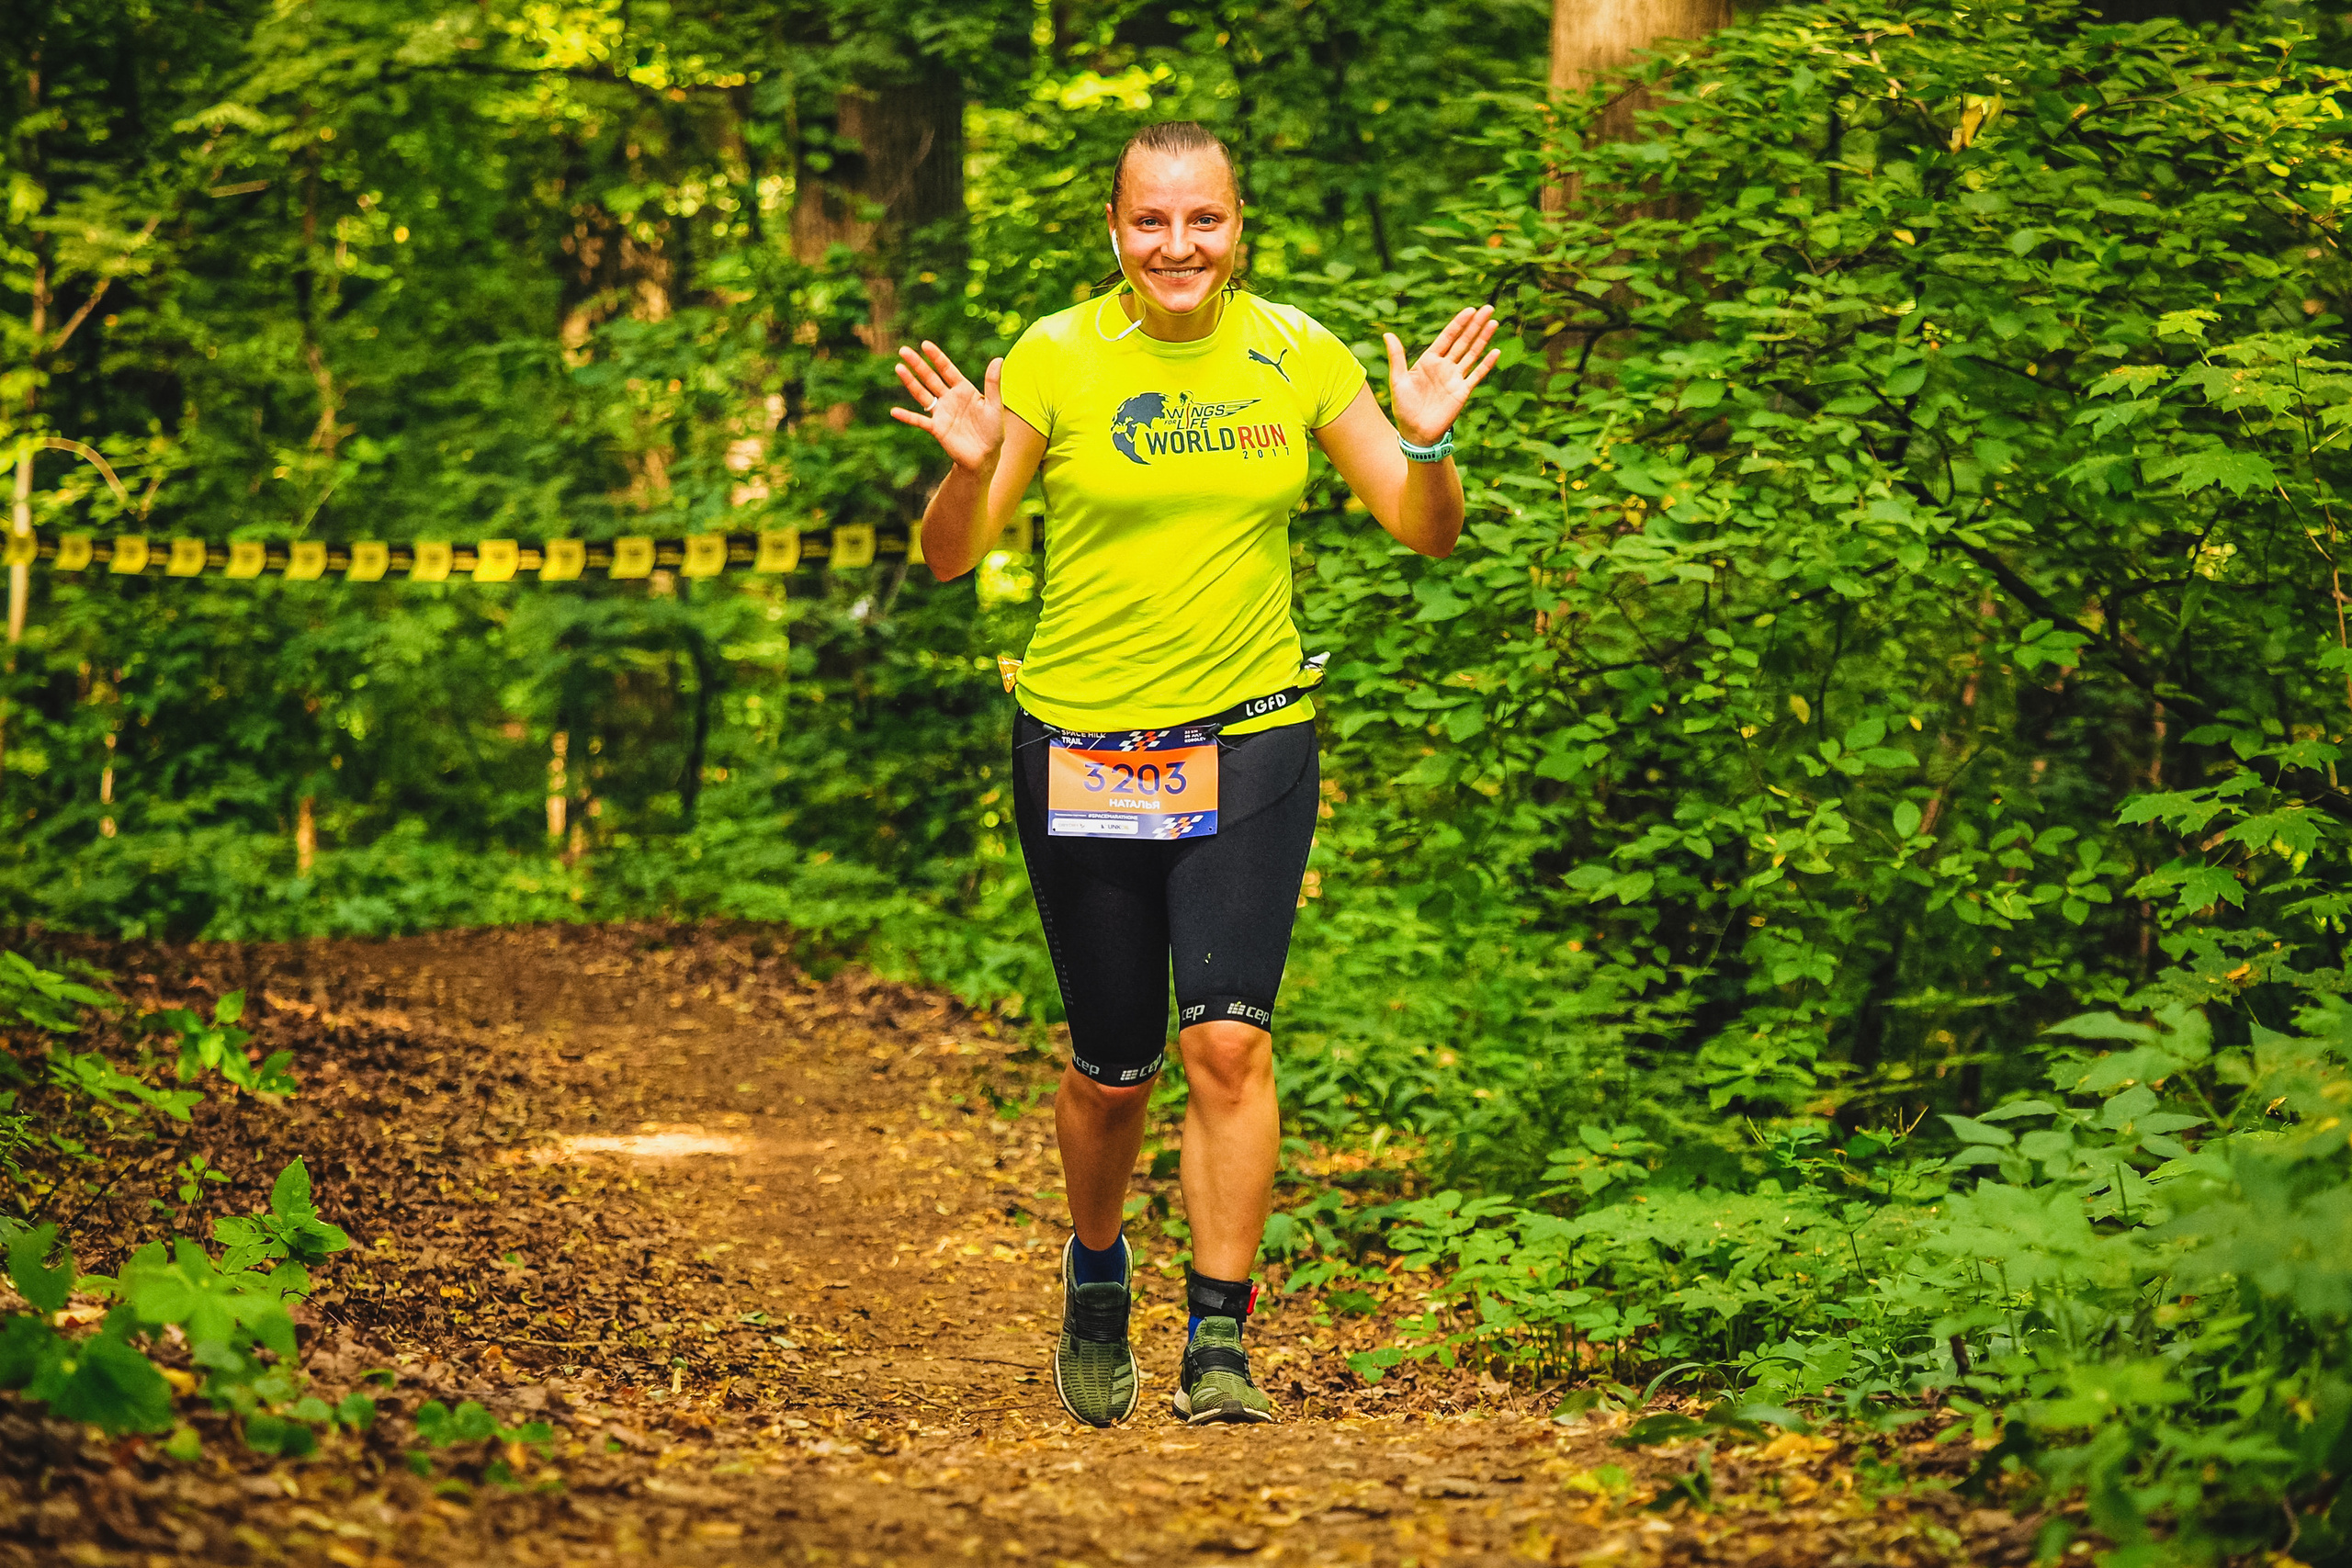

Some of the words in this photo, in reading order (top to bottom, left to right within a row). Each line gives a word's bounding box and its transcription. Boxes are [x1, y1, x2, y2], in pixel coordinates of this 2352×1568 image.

[1166, 404, 1226, 419] WINGS
[1176, 417, 1210, 430] LIFE
[1145, 427, 1236, 455] WORLD
[1238, 423, 1287, 449] RUN
[1242, 446, 1290, 459] 2017
[1245, 694, 1287, 716] LGFD
[1061, 737, 1083, 745] TRAIL
[1083, 761, 1187, 795] 3203
[1108, 798, 1161, 810] НАТАЛЬЯ
[1246, 1006, 1270, 1025] cep
[1076, 1055, 1100, 1076] cep
